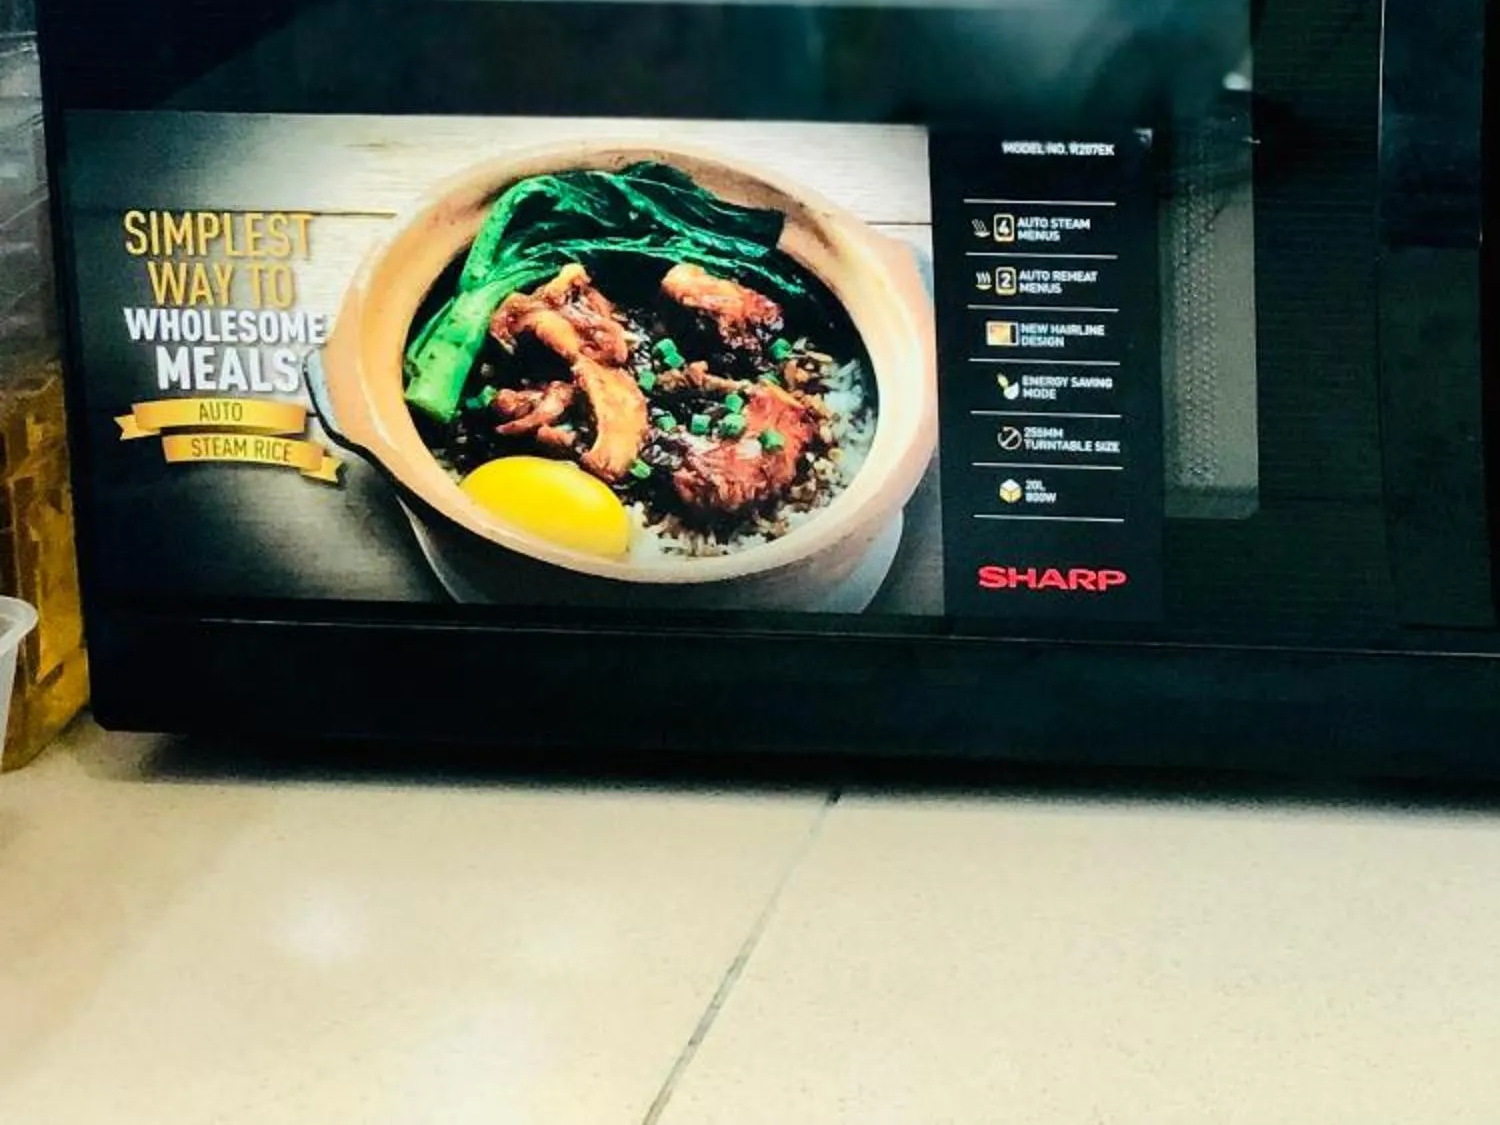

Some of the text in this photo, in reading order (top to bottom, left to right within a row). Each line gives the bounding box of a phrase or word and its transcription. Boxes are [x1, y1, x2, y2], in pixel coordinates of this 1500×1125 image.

[1001, 140, 1045, 155] MODEL
[1045, 142, 1069, 156] NO.
[1016, 216, 1049, 230] AUTO
[1049, 217, 1091, 231] STEAM
[124, 209, 315, 259] SIMPLEST
[1017, 230, 1061, 242] MENUS
[1019, 269, 1050, 282] AUTO
[1051, 270, 1099, 283] REHEAT
[148, 260, 296, 309] WAY TO
[1019, 282, 1063, 295] MENUS
[123, 307, 326, 344] WHOLESOME
[1020, 322, 1106, 336] NEW HAIRLINE
[1021, 336, 1066, 348] DESIGN
[155, 346, 299, 393] MEALS
[1021, 375, 1114, 389] ENERGY SAVING
[1022, 388, 1058, 400] MODE
[198, 402, 244, 422] AUTO
[190, 439, 293, 463] STEAM RICE
[1023, 439, 1093, 453] TURNTABLE
[977, 565, 1129, 592] SHARP
